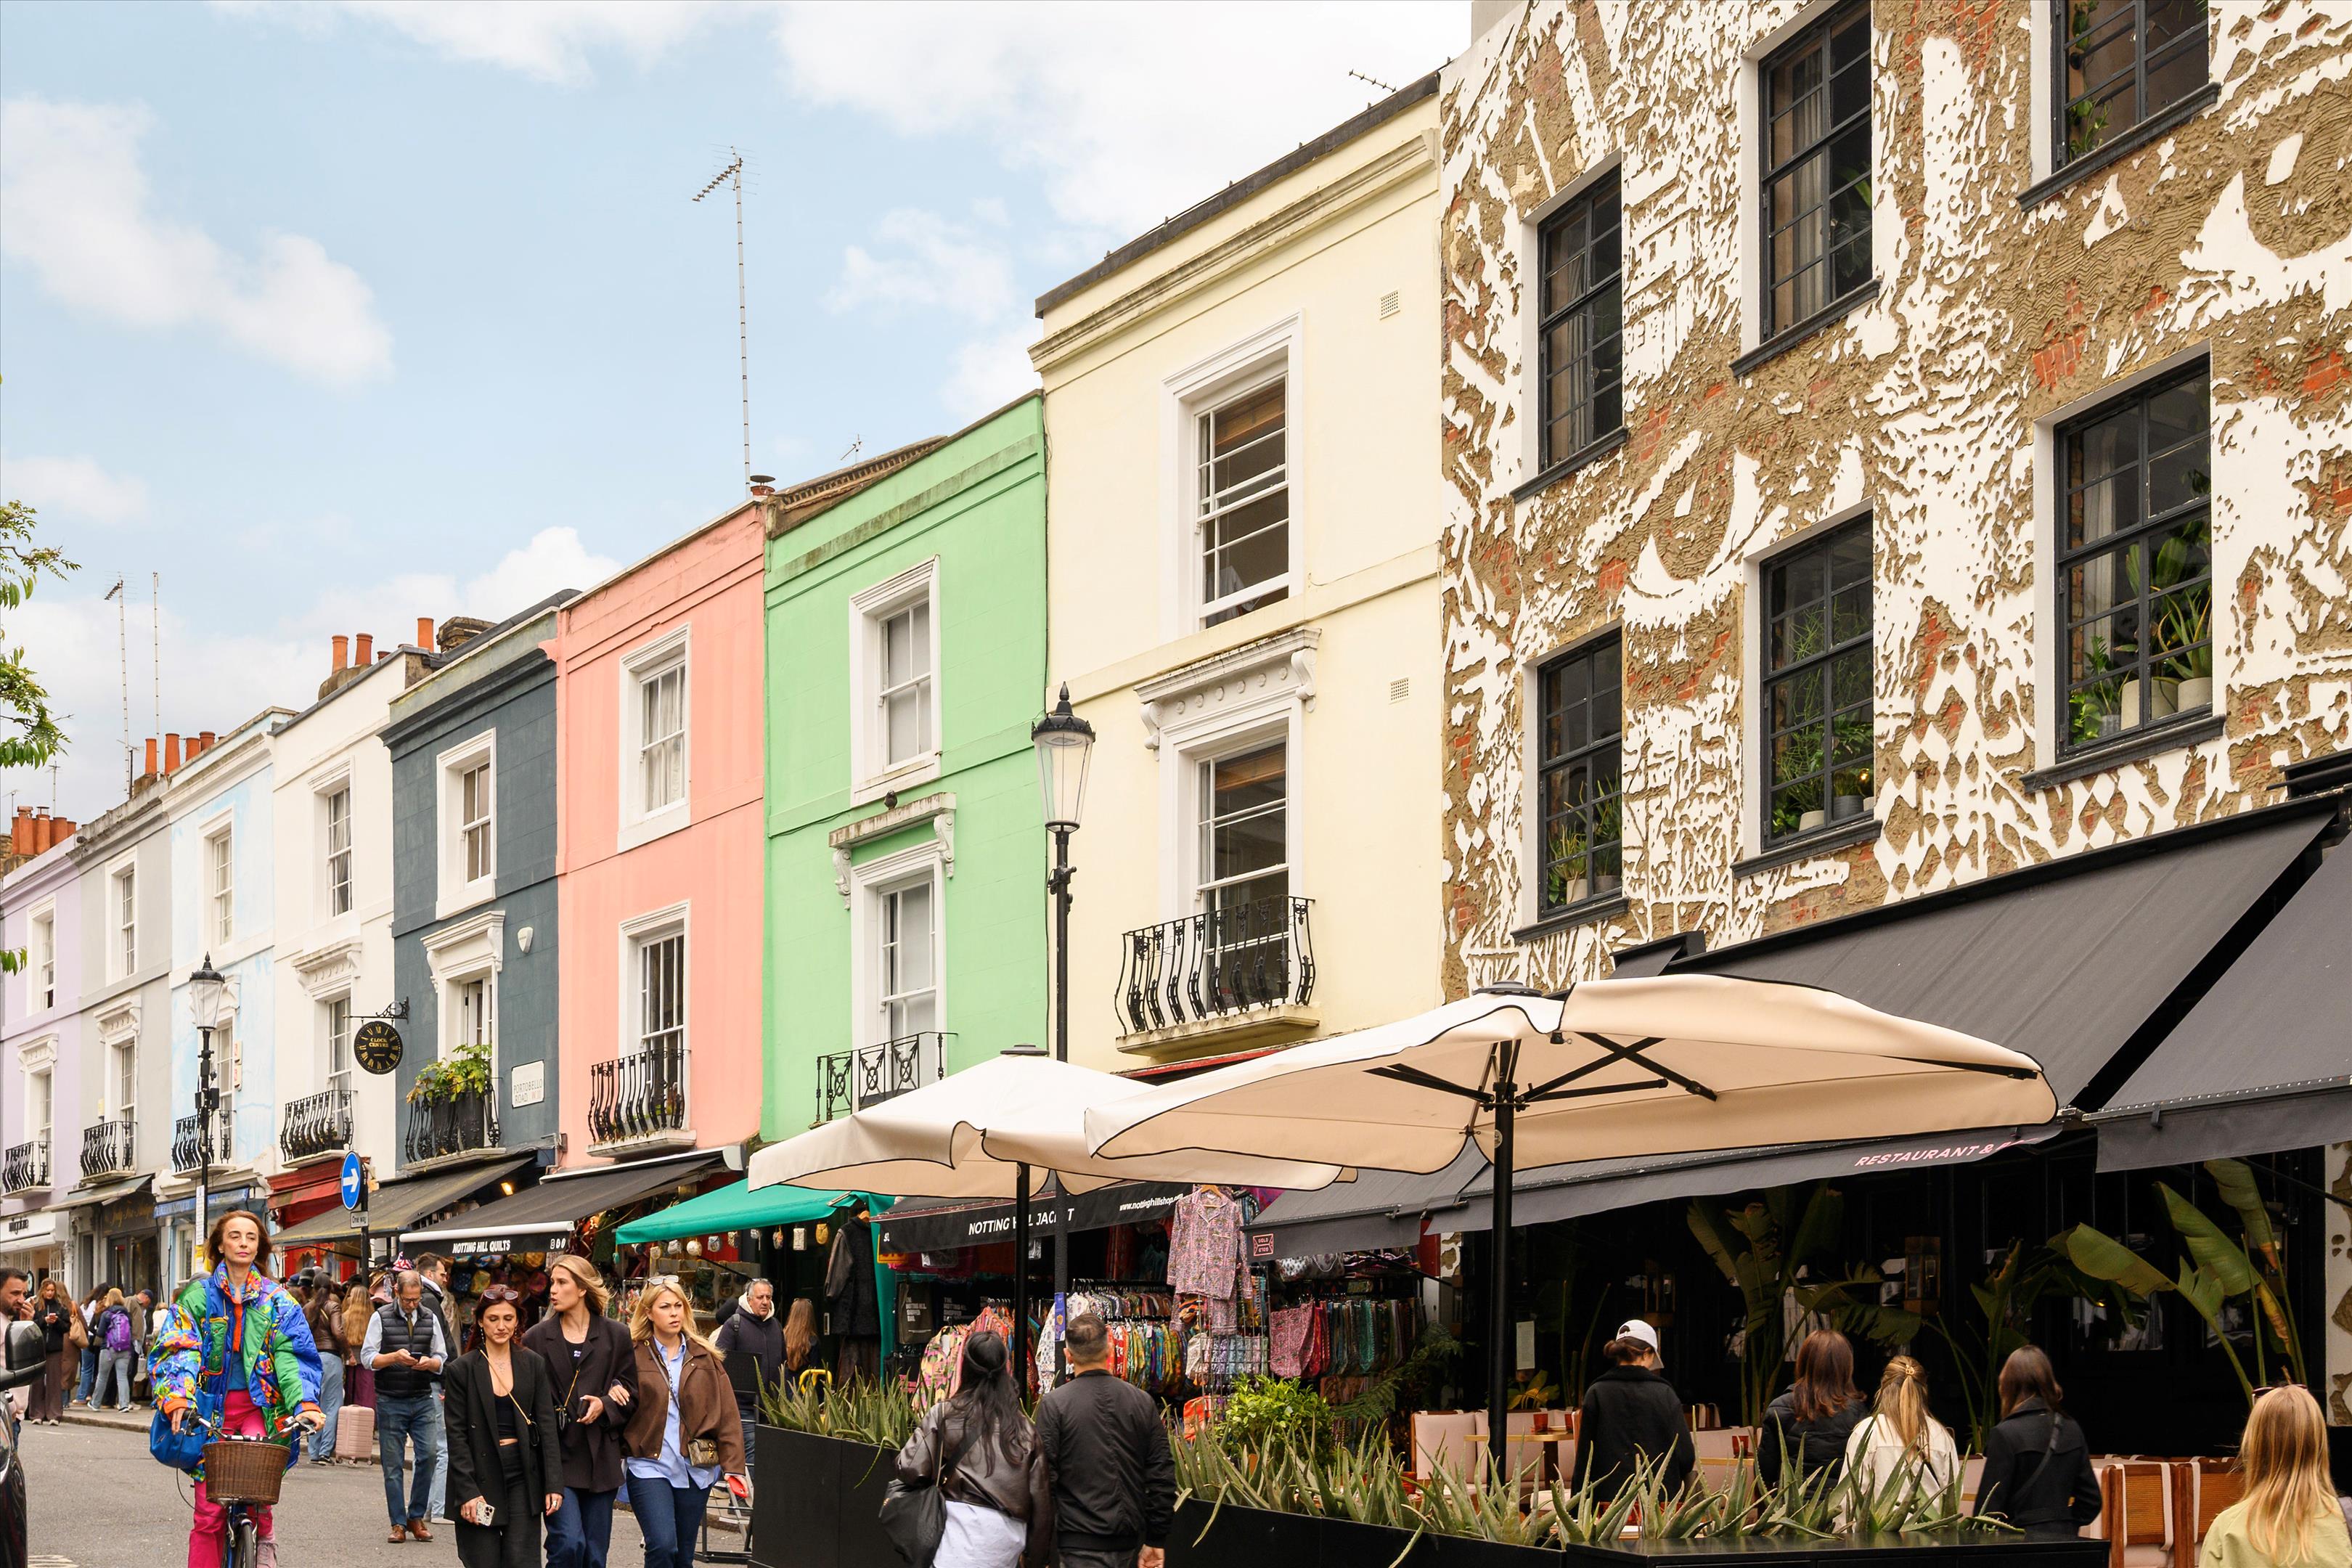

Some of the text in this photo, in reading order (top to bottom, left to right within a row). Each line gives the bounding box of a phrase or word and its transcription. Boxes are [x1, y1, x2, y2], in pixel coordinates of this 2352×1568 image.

[513, 1079, 542, 1095] PORTOBELLO
[515, 1093, 528, 1104] ROAD
[1855, 1146, 1980, 1167] RESTAURANT
[1979, 1143, 1994, 1154] &
[968, 1217, 1010, 1236] NOTTING
[1036, 1208, 1075, 1226] JACT
[452, 1239, 511, 1254] NOTTING HILL QUILTS
